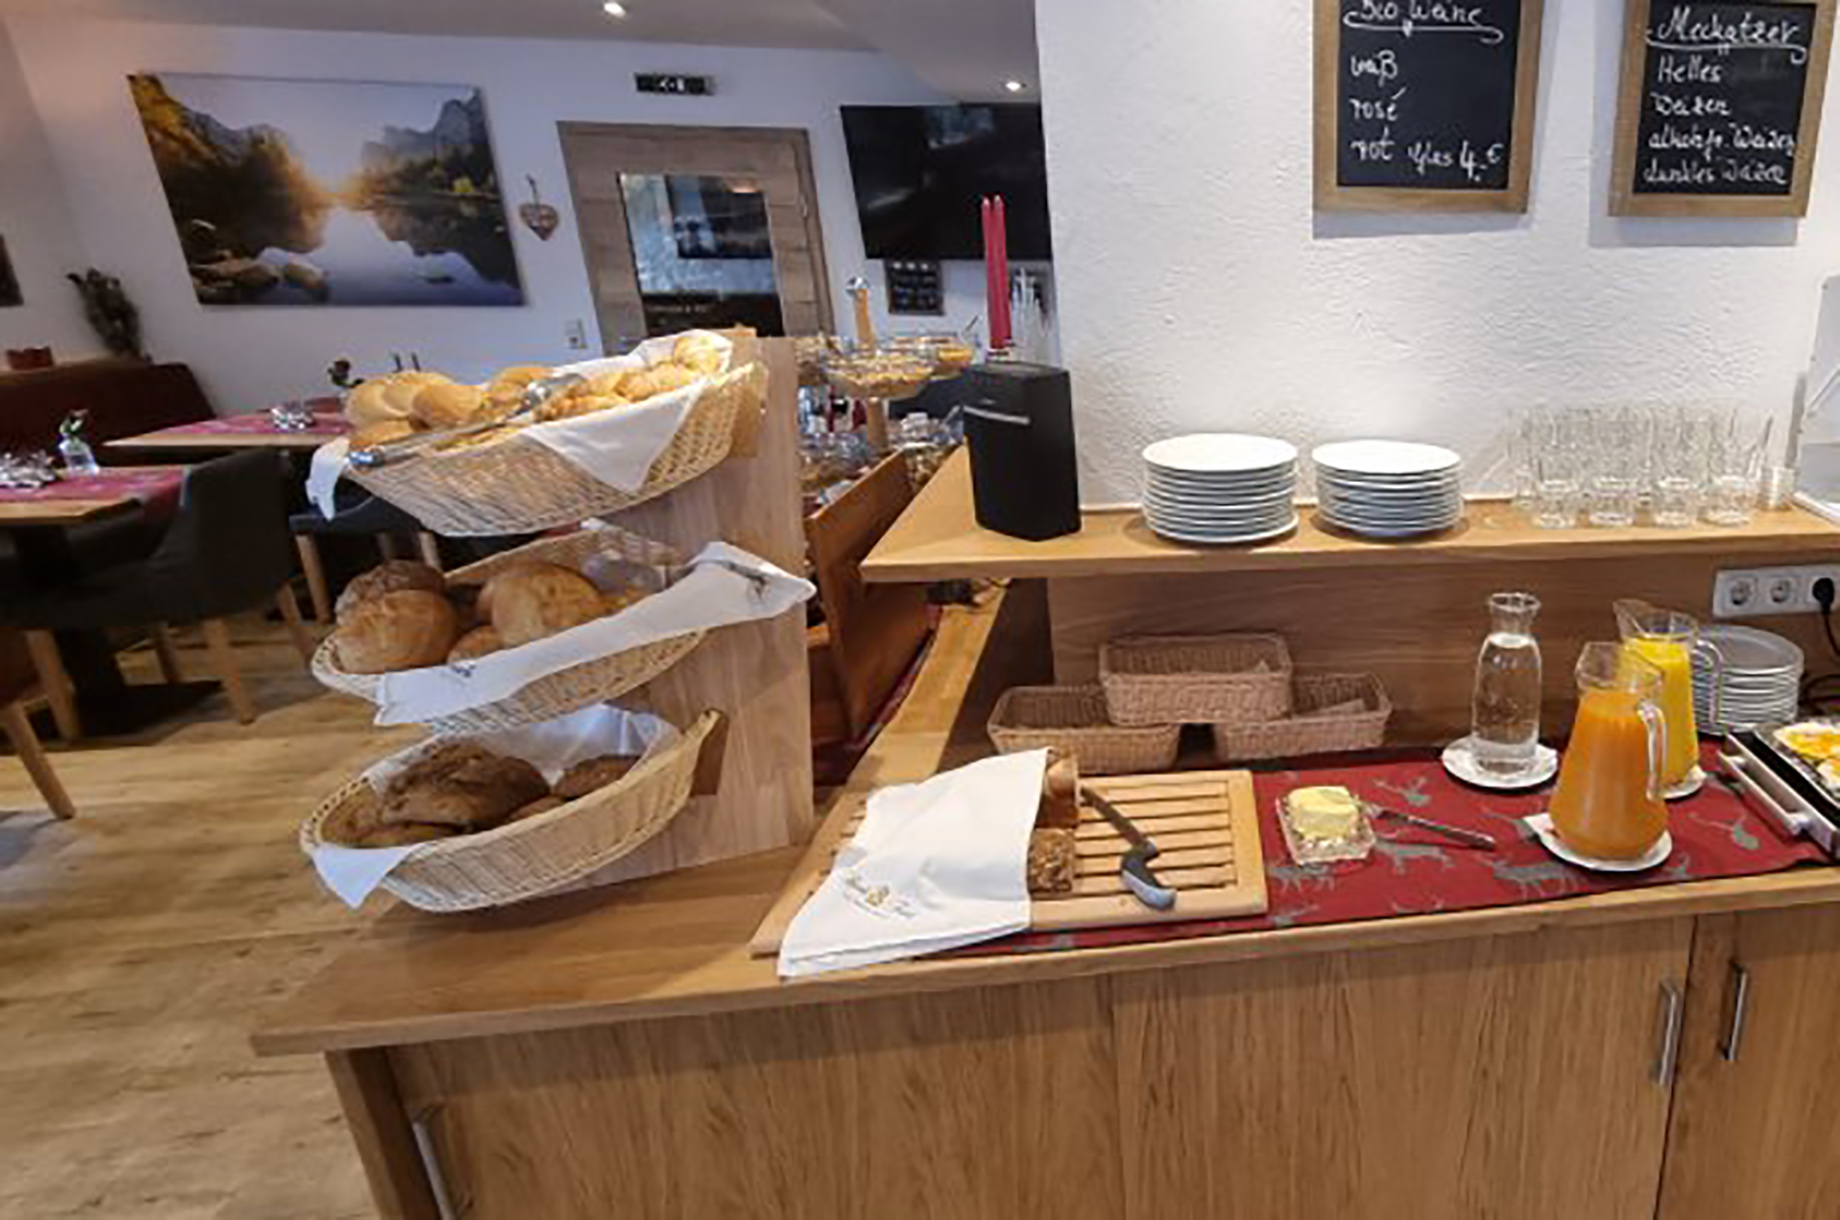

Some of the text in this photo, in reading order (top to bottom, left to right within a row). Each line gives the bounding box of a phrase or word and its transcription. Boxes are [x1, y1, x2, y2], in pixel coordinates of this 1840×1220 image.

[1657, 54, 1722, 83] Helles
[1349, 86, 1407, 122] rosé
[1350, 125, 1395, 161] rot
